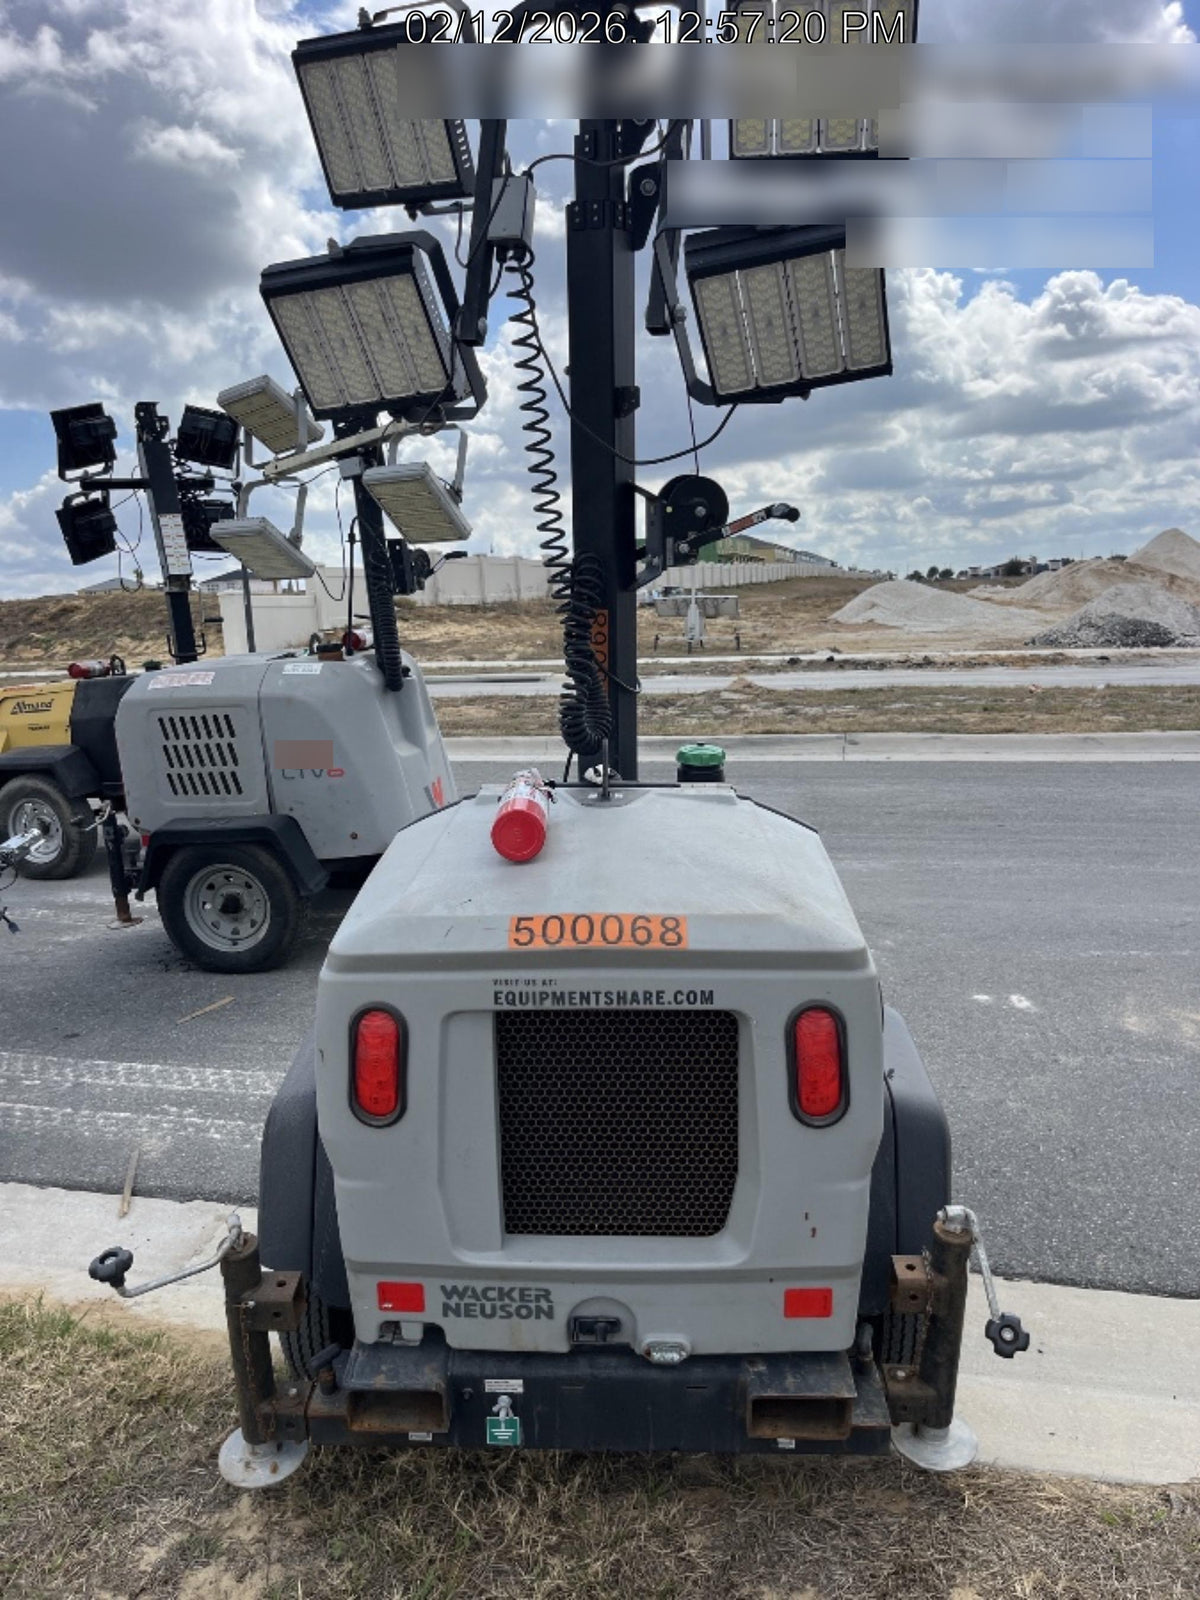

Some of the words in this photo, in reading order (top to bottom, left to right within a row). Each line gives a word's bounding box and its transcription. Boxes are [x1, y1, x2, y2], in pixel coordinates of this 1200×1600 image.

[513, 915, 684, 947] 500068
[493, 990, 714, 1006] EQUIPMENTSHARE.COM
[440, 1285, 552, 1302] WACKER
[442, 1303, 554, 1319] NEUSON
